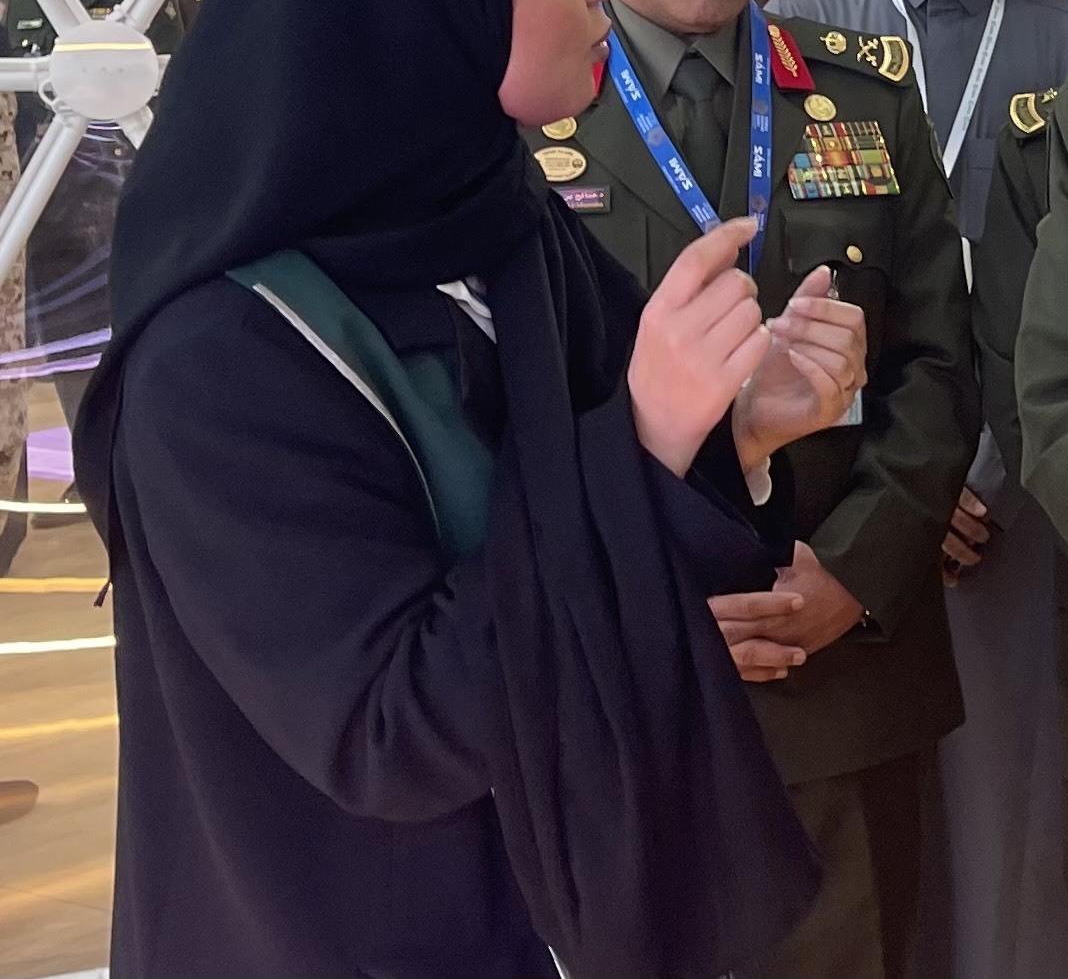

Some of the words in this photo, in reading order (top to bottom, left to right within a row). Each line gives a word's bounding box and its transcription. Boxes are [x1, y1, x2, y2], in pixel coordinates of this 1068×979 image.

[620, 69, 642, 101] SAMI
[754, 52, 766, 85] SAMI
[668, 157, 693, 191] SAMI
[753, 145, 766, 178] SAMI
